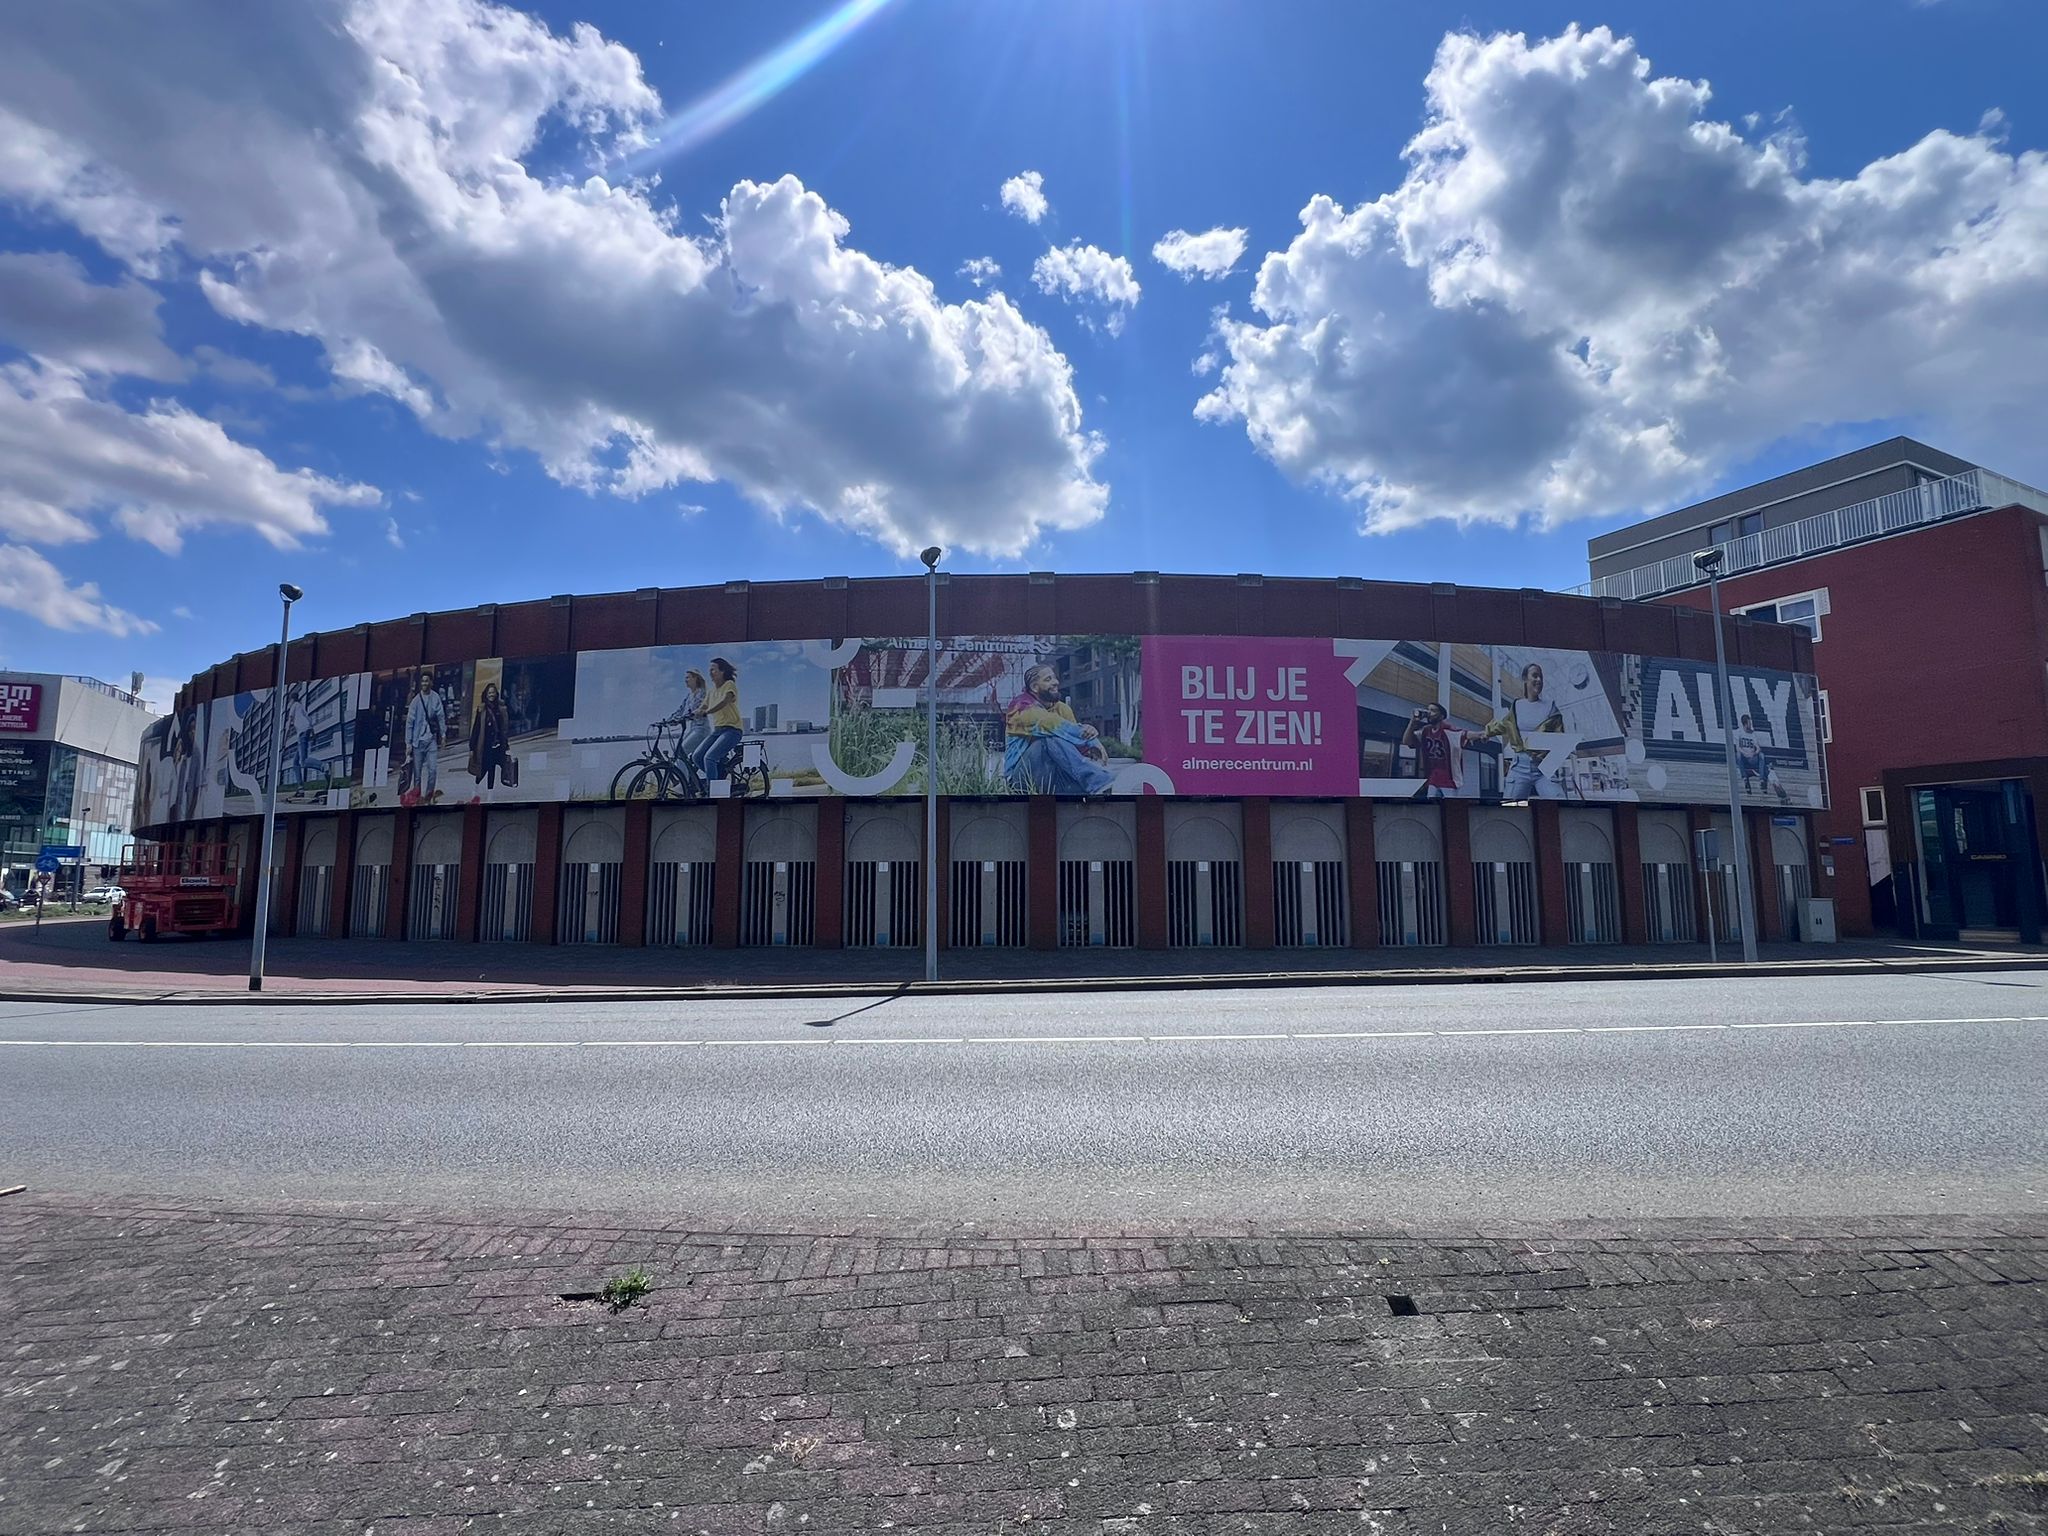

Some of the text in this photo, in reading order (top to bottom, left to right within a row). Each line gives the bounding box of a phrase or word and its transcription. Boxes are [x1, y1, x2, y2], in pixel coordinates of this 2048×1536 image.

[1181, 665, 1308, 701] BLIJ JE
[1180, 709, 1322, 745] TE ZIEN!
[1182, 757, 1313, 771] almerecentrum.nl
